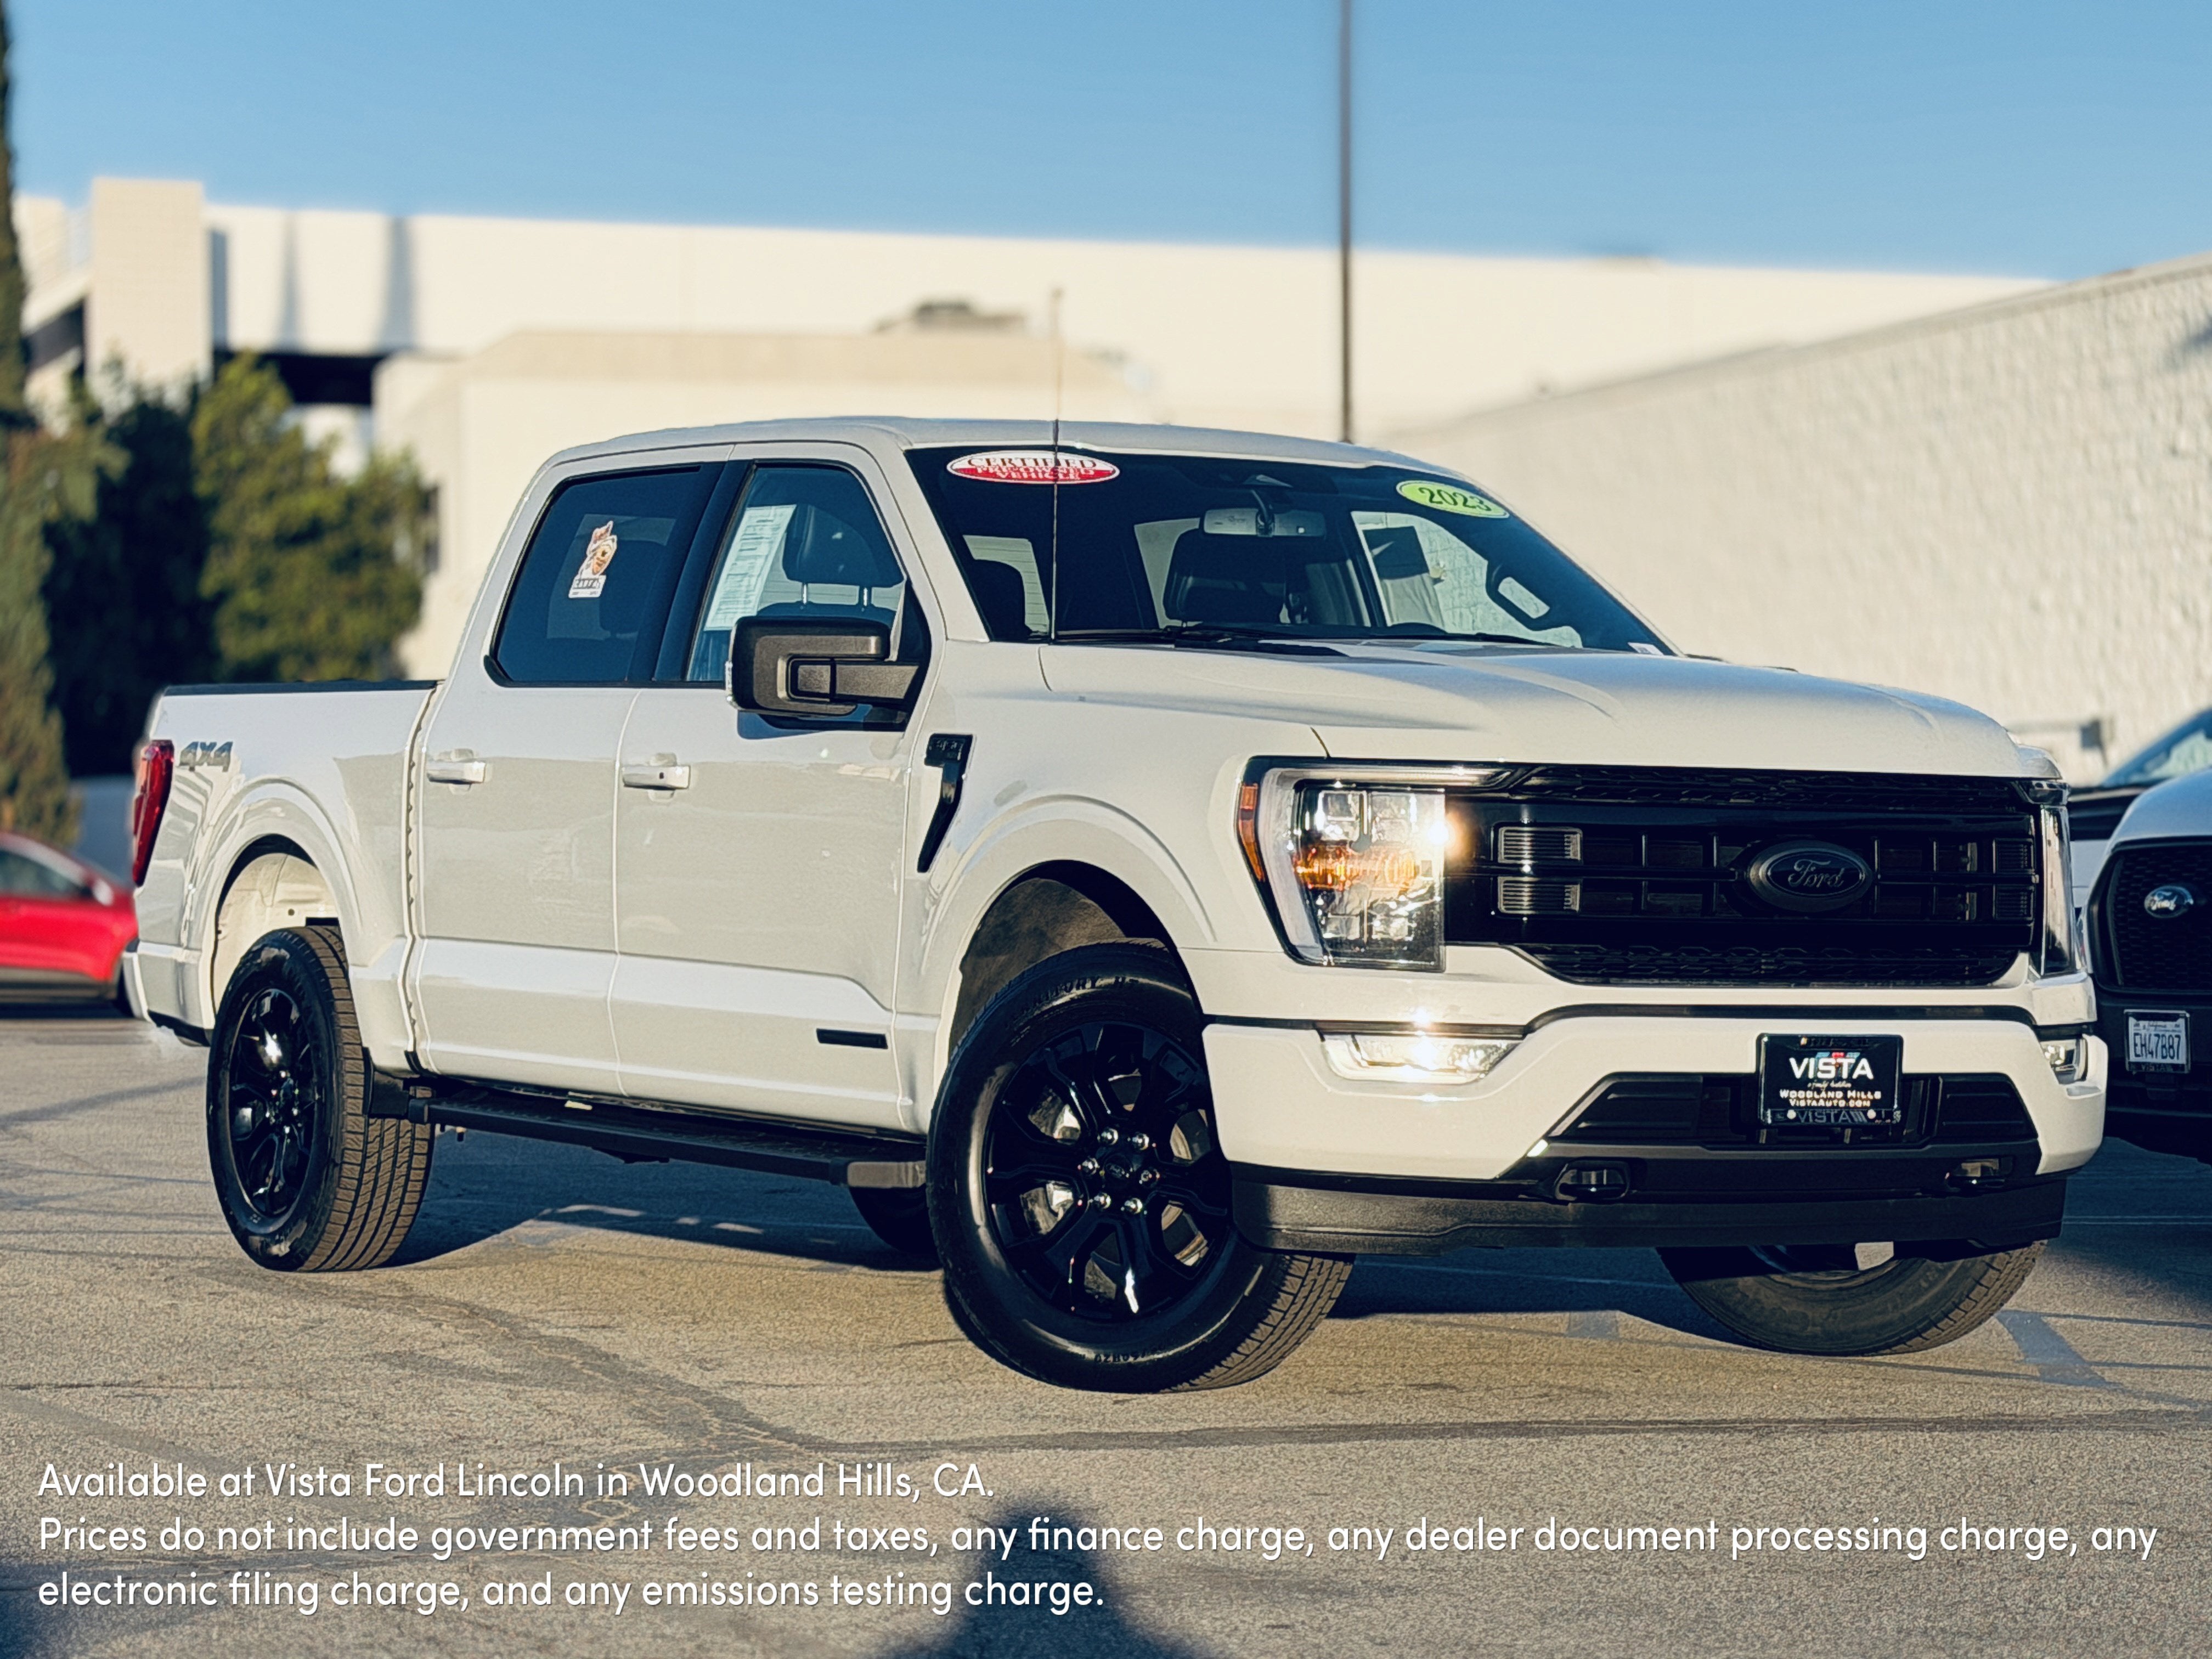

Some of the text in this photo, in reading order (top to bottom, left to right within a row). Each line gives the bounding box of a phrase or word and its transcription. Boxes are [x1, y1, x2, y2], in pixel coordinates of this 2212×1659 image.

[968, 458, 1096, 468] CERTIFIED
[1418, 487, 1491, 511] 2023
[1788, 859, 1845, 888] Ford
[1789, 1057, 1874, 1080] VISTA
[1780, 1089, 1882, 1099] WOODLAND HILLS
[1797, 1110, 1852, 1124] VISTA
